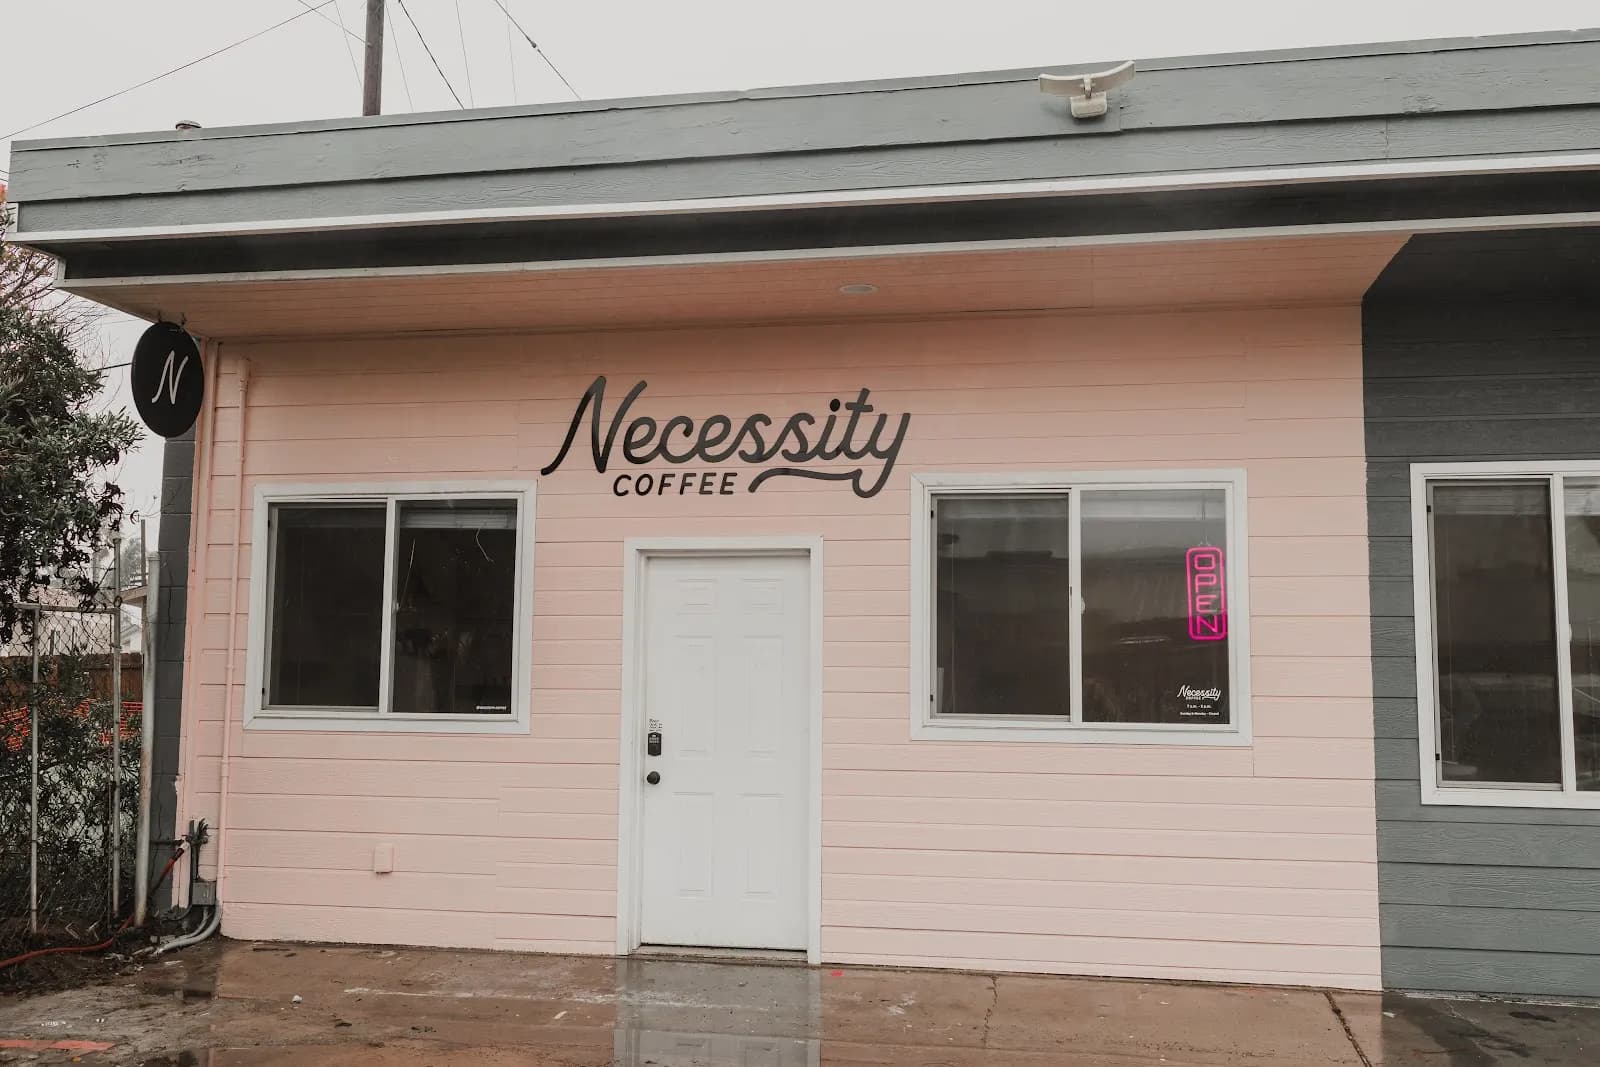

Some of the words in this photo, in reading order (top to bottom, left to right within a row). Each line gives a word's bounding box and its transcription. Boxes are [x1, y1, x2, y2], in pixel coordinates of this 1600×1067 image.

[540, 375, 911, 498] Necessity
[613, 472, 738, 496] COFFEE
[1194, 554, 1218, 633] OPEN
[1176, 684, 1221, 701] Necessity
